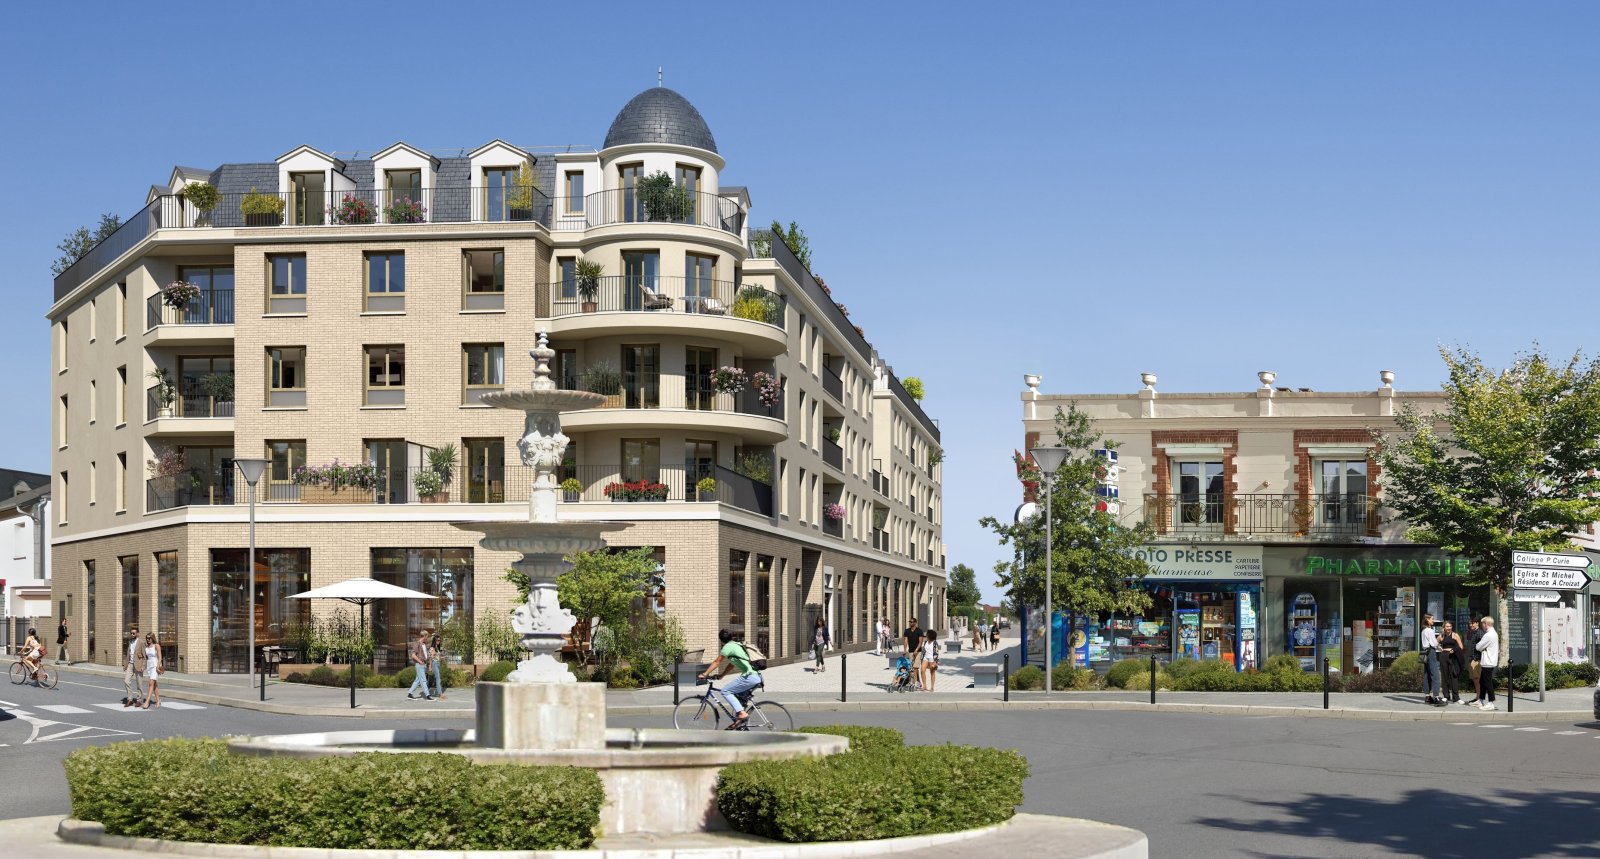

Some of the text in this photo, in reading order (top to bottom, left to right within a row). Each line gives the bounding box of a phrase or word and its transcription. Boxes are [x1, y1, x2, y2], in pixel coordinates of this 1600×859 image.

[1175, 550, 1233, 563] PRESSE
[1305, 556, 1470, 575] PHARMACIE
[1516, 570, 1539, 579] Eglise
[1517, 578, 1550, 586] Résidence
